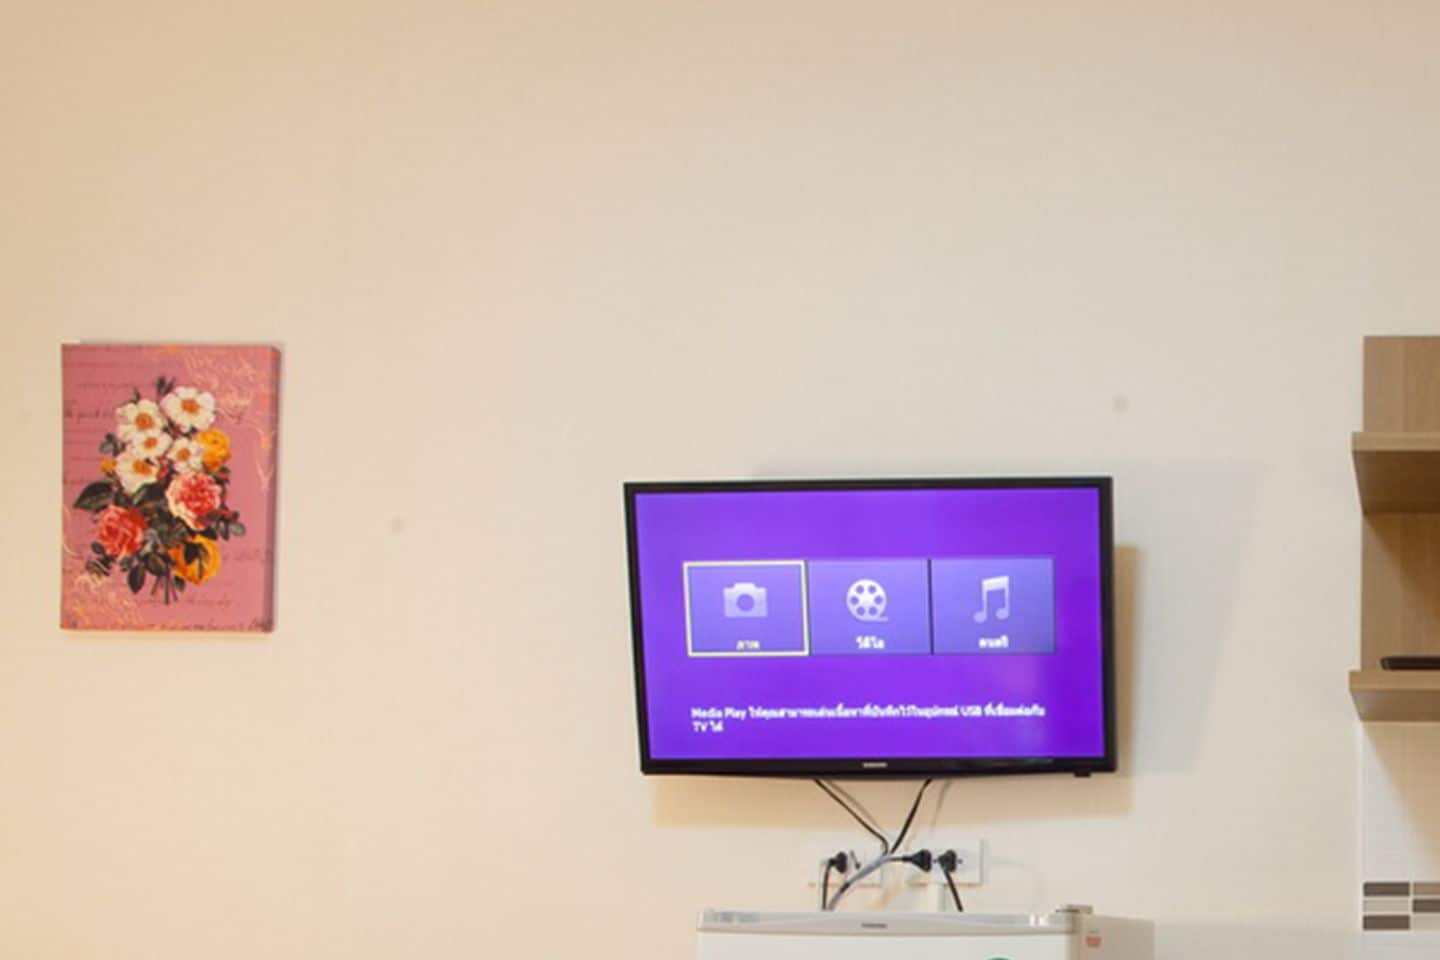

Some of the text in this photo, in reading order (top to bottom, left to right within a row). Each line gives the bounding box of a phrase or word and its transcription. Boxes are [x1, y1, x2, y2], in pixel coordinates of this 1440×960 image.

[723, 706, 747, 720] Play
[960, 706, 981, 718] USB
[692, 721, 708, 733] TV
